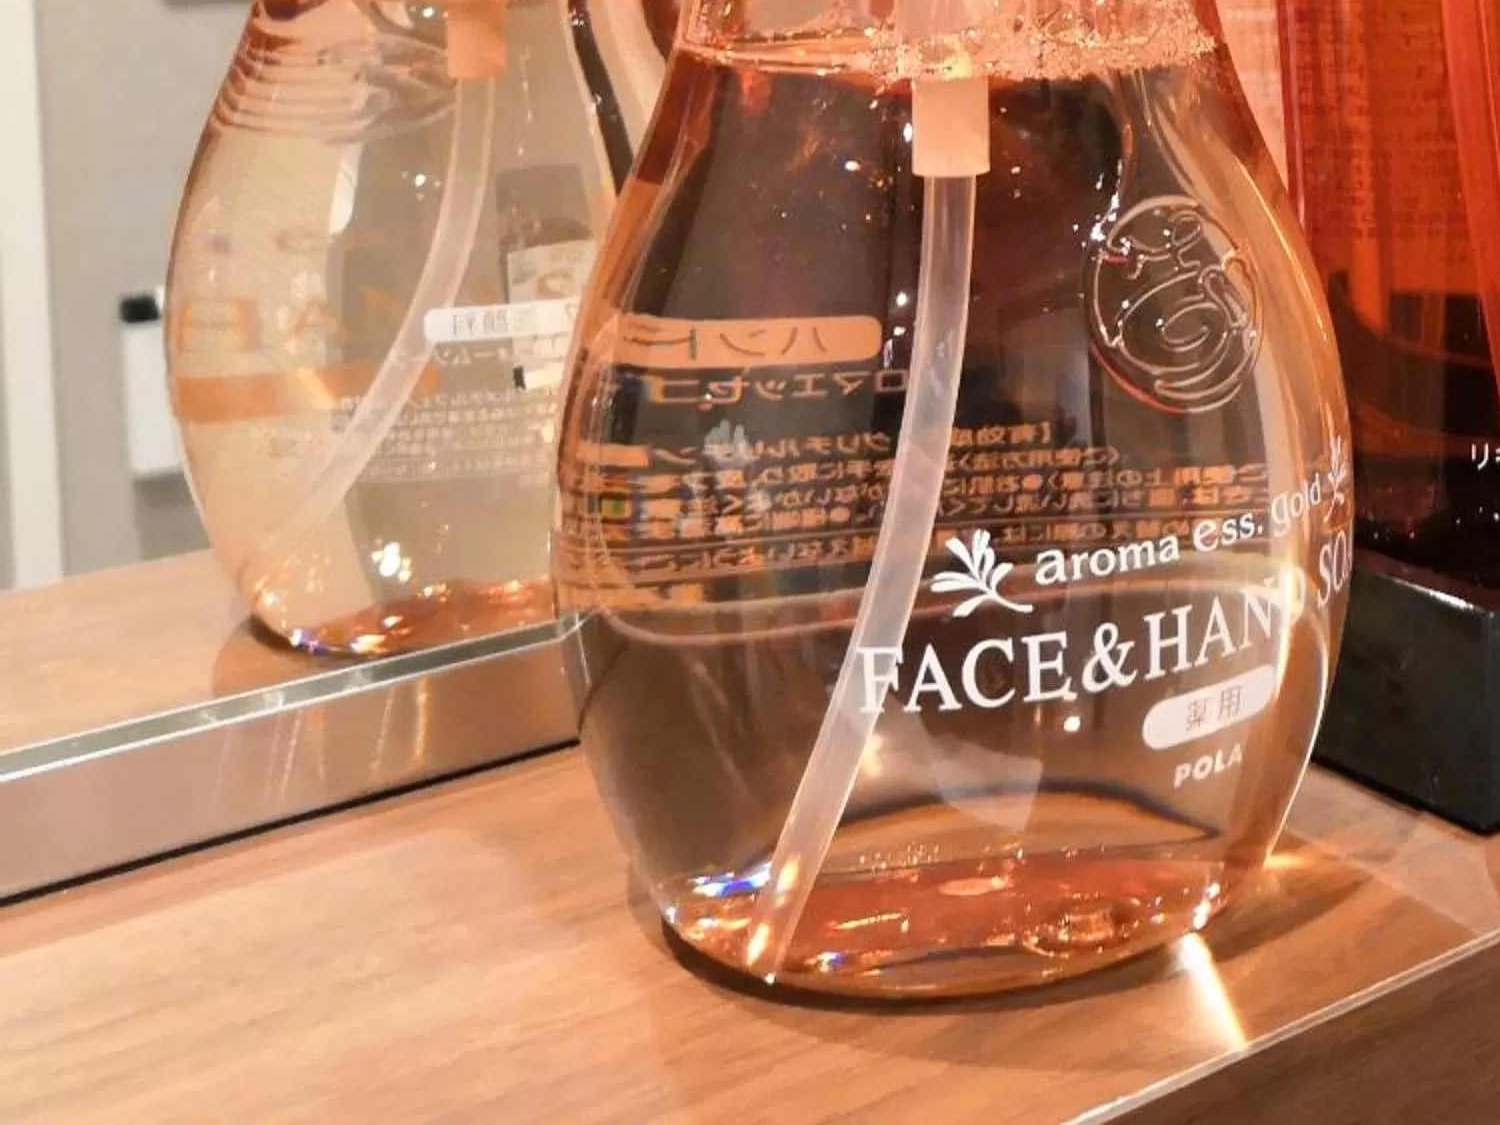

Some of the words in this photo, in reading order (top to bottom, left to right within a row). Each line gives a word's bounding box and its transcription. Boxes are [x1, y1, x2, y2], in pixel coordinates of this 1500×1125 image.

[1034, 529, 1181, 587] aroma
[1192, 509, 1264, 553] ess.
[1269, 472, 1322, 539] gold
[1173, 742, 1243, 790] POLA
